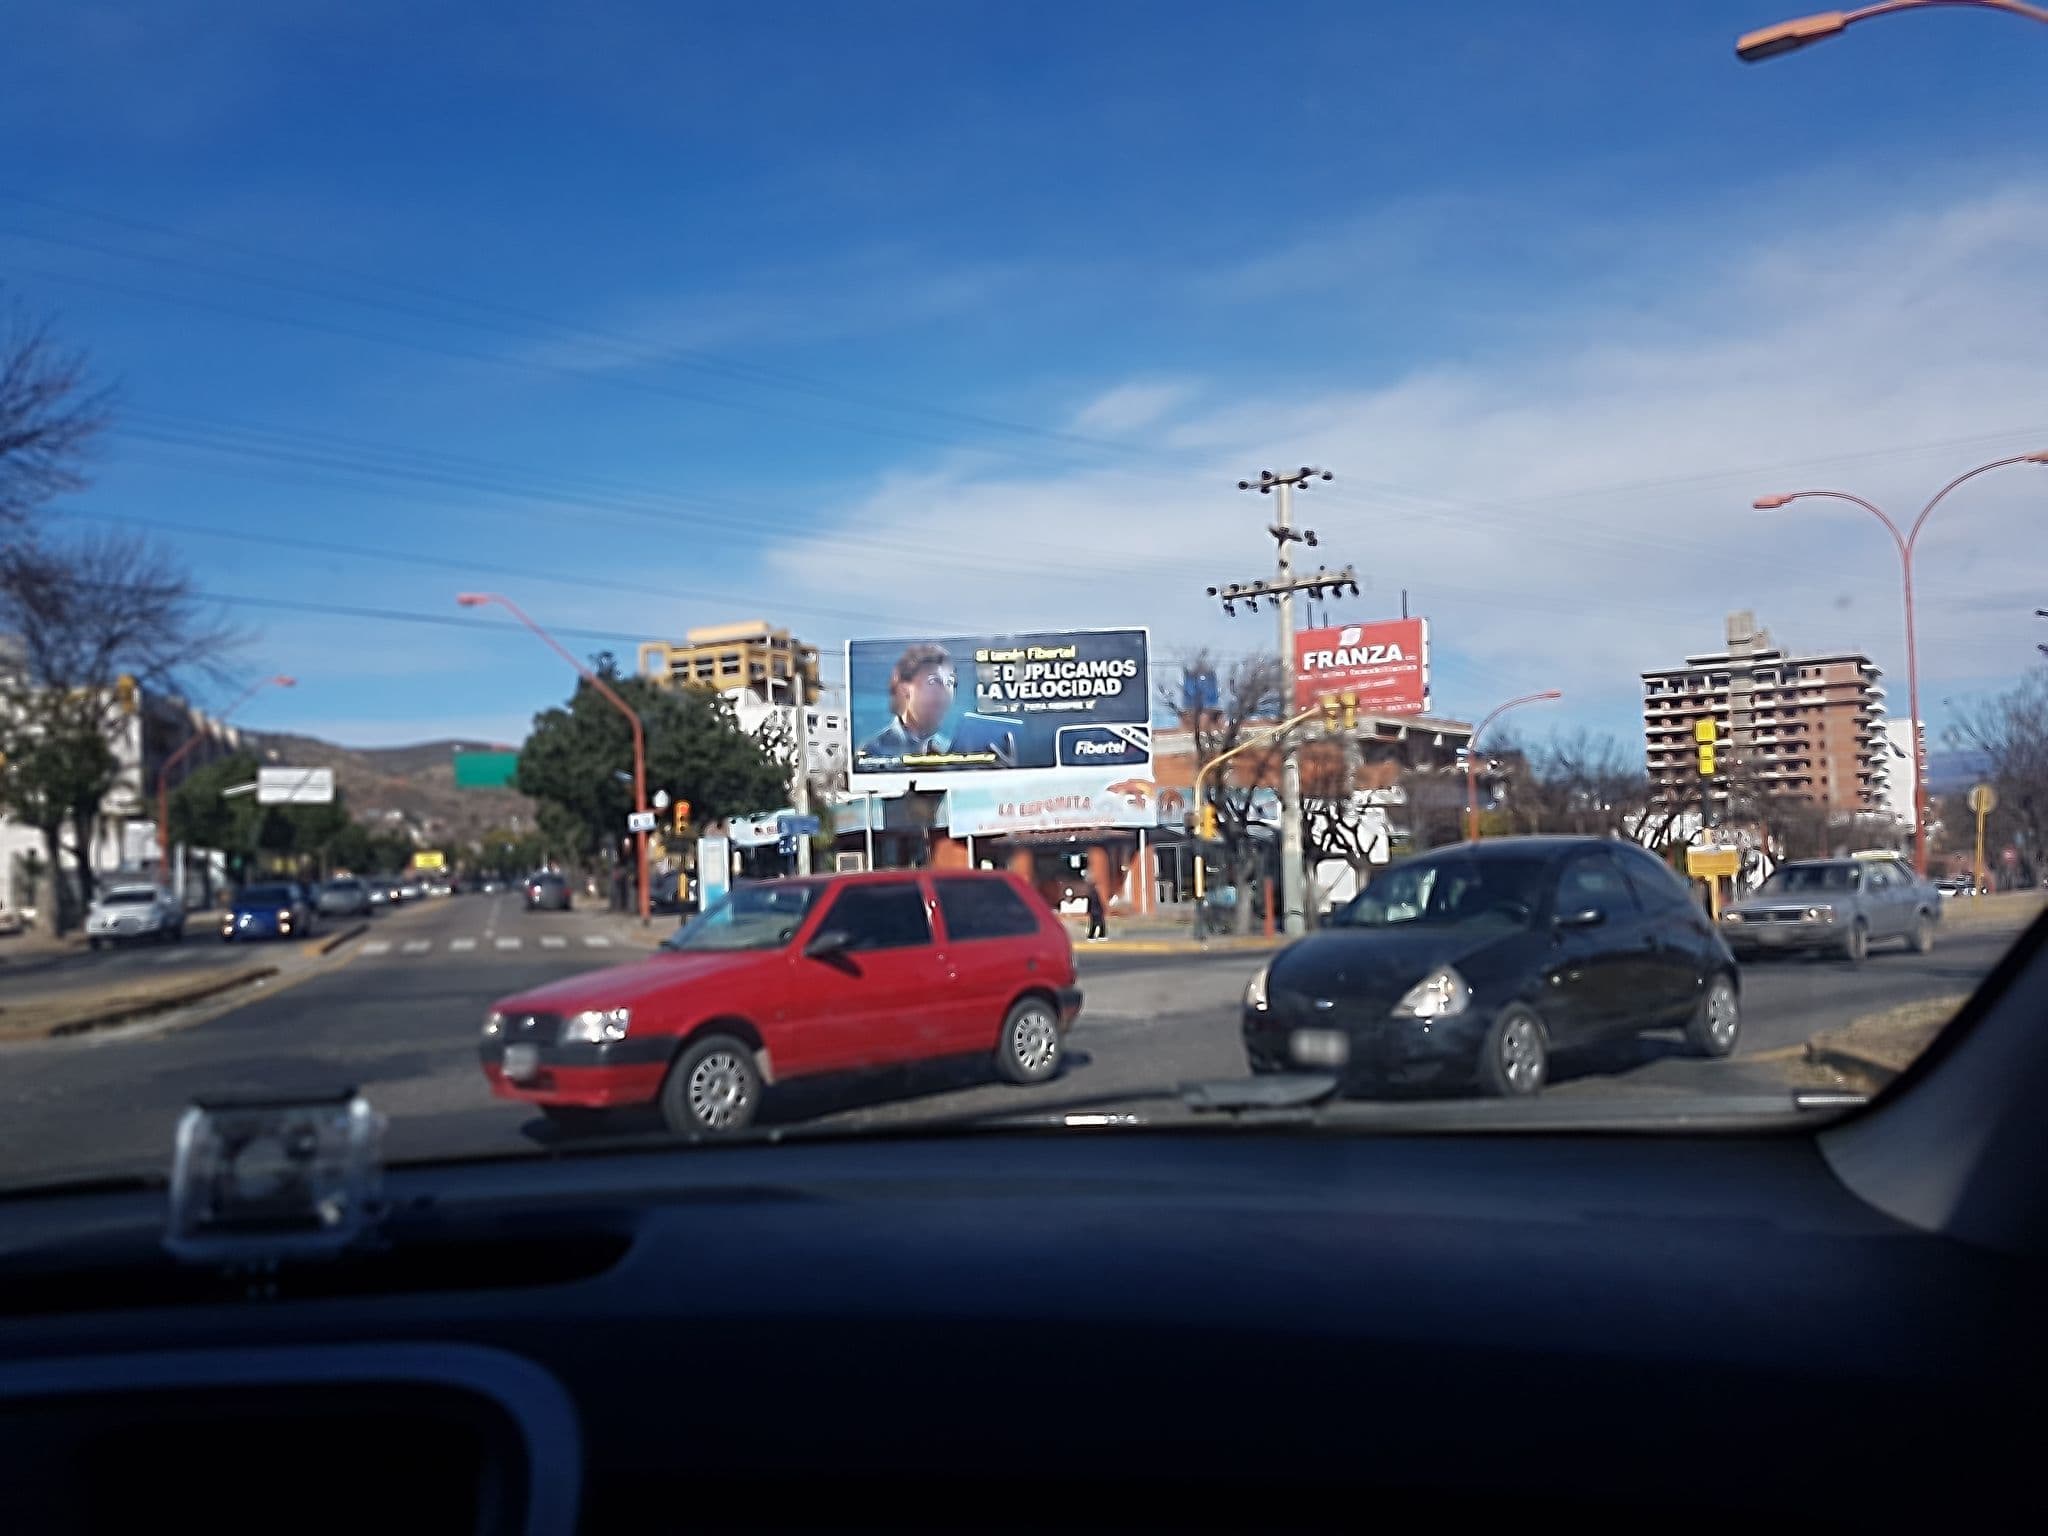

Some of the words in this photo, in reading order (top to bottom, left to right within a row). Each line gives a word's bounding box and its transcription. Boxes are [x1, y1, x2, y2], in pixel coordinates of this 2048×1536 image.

[1027, 645, 1076, 660] Fibertel
[1303, 643, 1403, 671] FRANZA
[977, 682, 1003, 700] LA
[1005, 677, 1123, 700] VELOCIDAD
[1075, 739, 1127, 756] Fibertel
